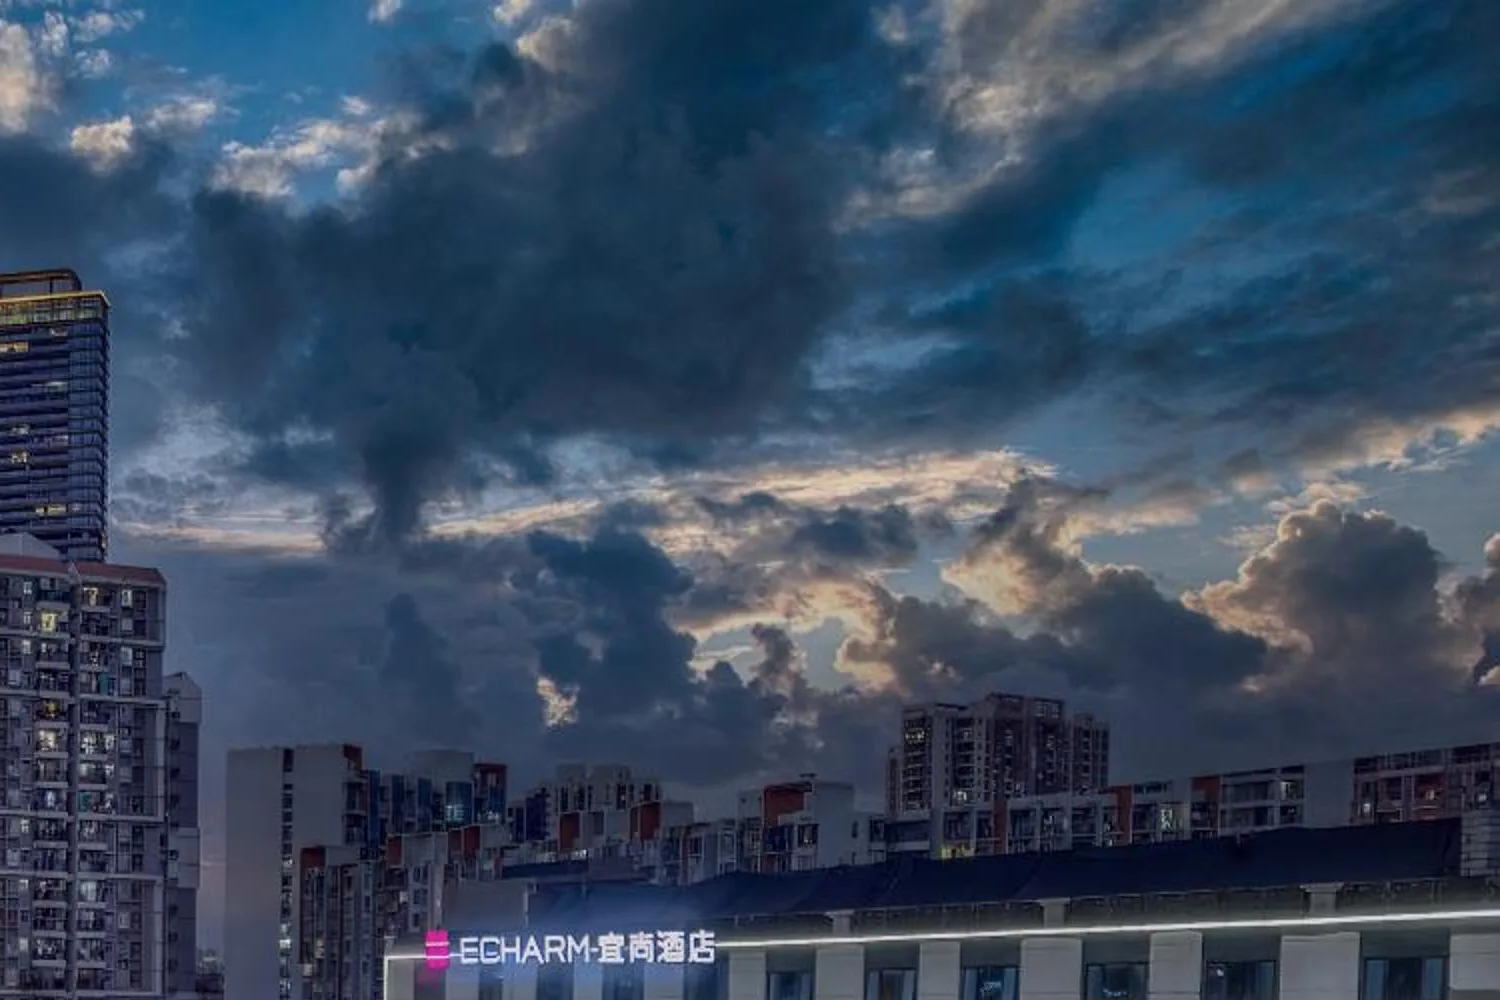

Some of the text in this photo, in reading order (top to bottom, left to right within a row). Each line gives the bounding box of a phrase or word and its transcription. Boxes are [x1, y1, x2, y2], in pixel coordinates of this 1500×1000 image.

[459, 930, 716, 964] ECHARM 宜尚酒店
